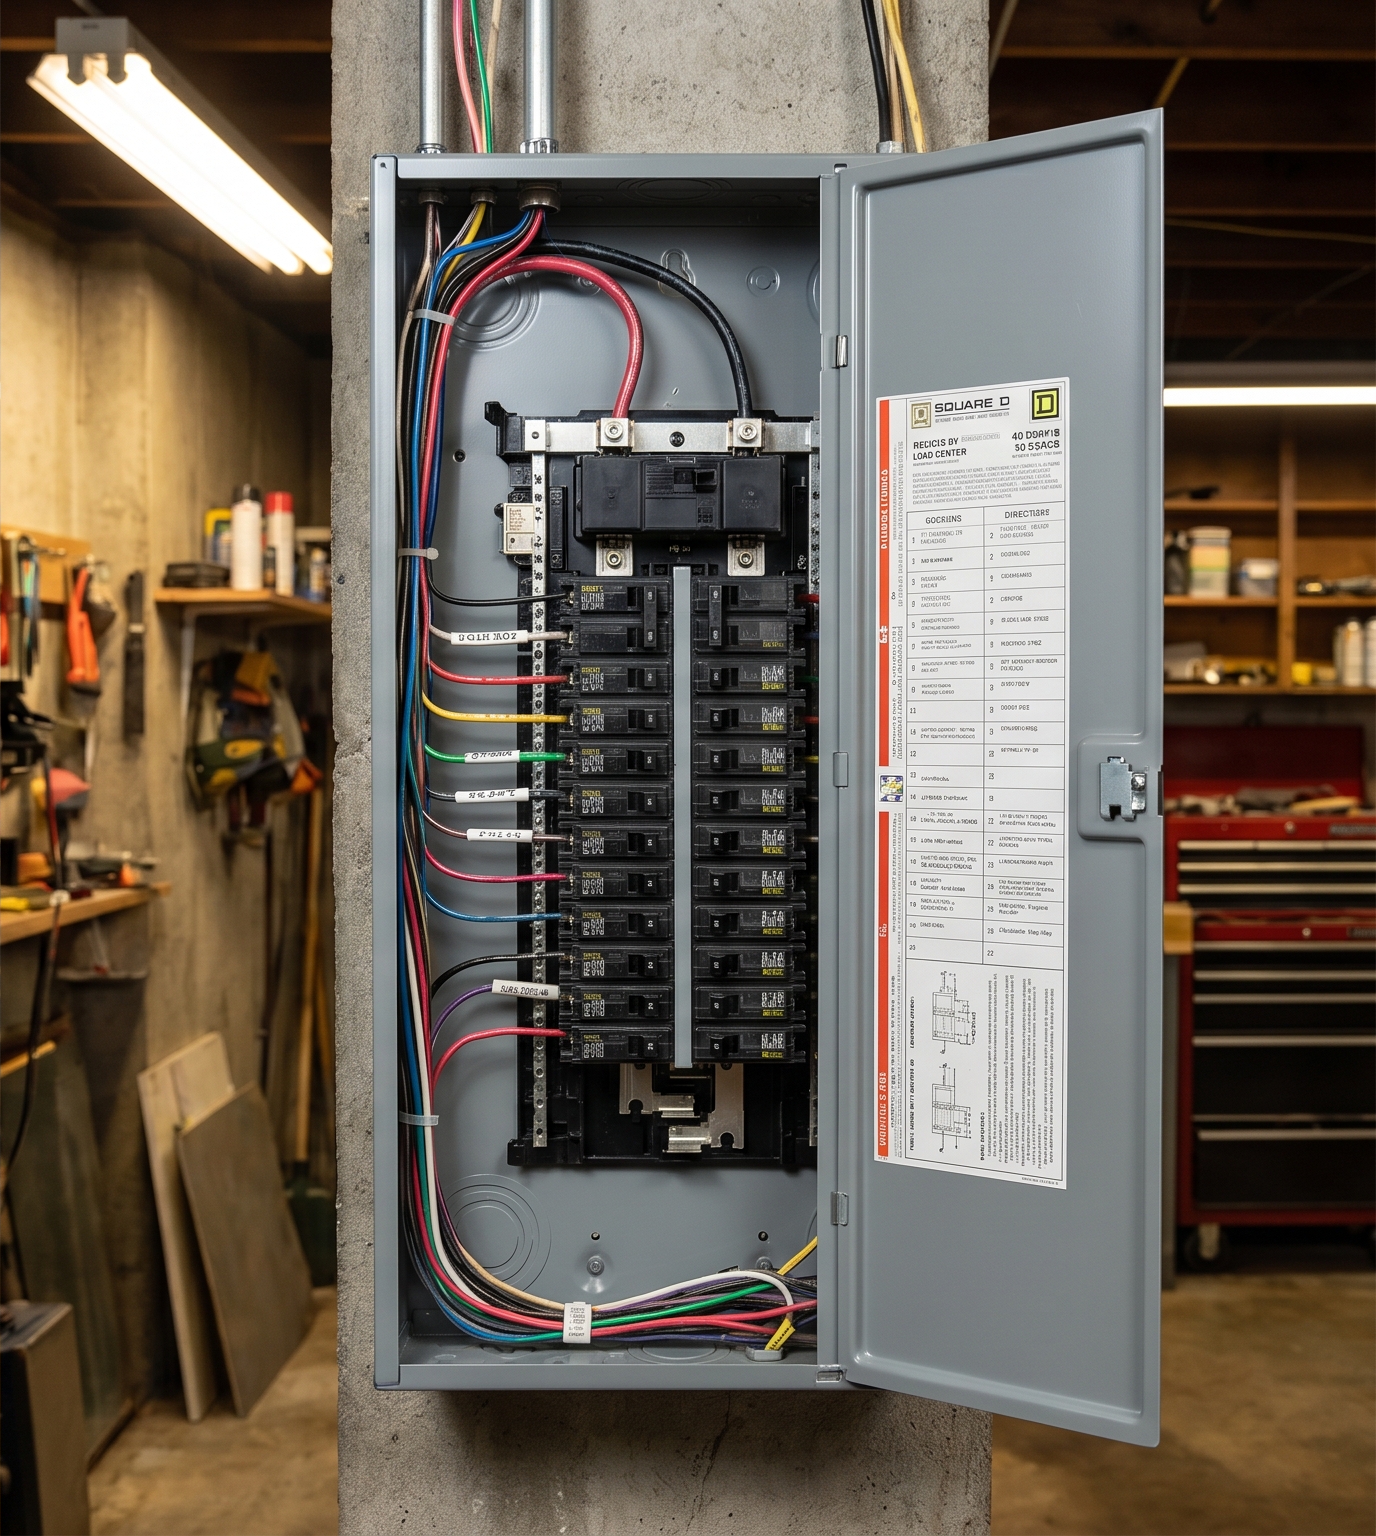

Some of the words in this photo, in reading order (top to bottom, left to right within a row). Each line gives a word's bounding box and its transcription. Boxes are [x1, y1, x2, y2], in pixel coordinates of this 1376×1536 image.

[934, 398, 993, 413] SQUARE
[1000, 396, 1010, 407] D
[948, 437, 959, 446] BY
[913, 451, 933, 461] LOAD
[935, 448, 967, 458] CENTER
